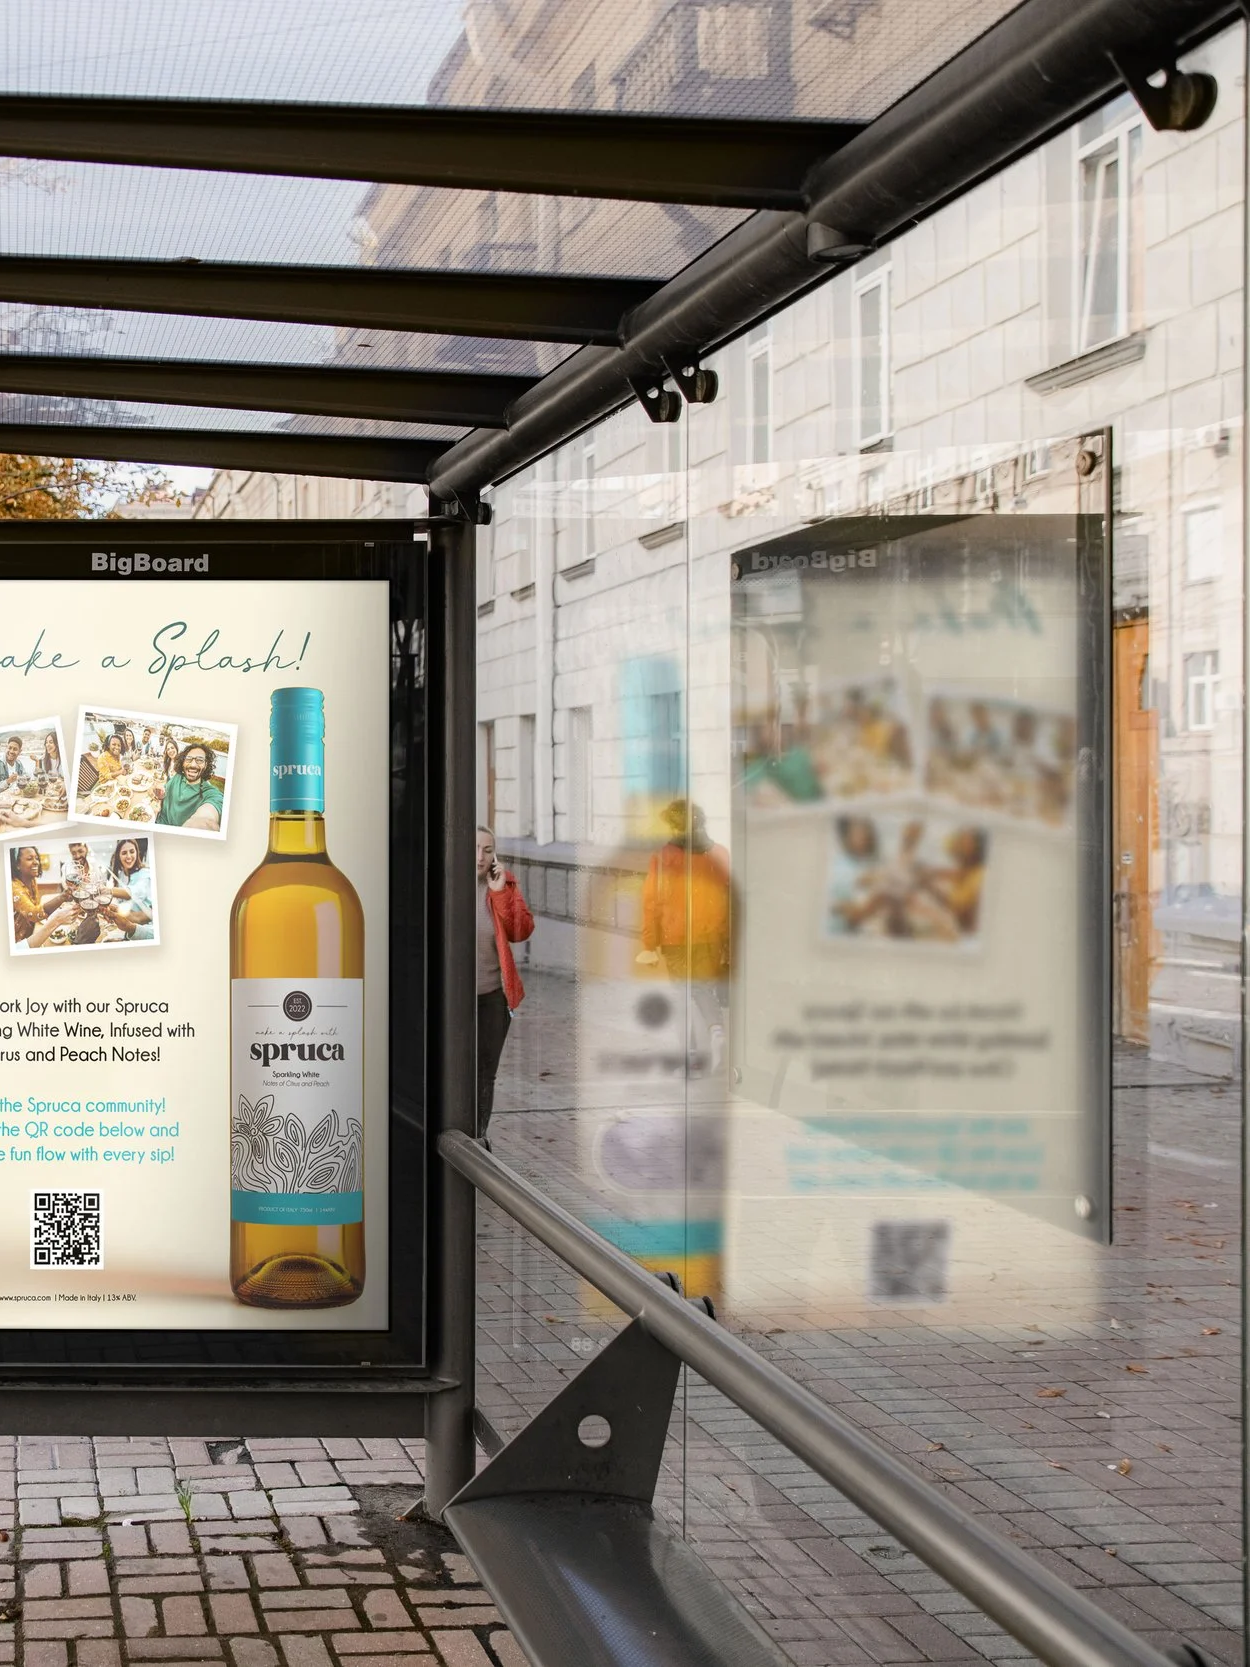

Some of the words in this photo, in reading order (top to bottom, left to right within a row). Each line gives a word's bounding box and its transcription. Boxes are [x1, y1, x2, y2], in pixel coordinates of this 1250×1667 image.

[91, 552, 209, 576] BigBoard
[101, 653, 130, 669] a
[148, 621, 312, 698] Splash!
[272, 764, 322, 780] spruca
[26, 998, 49, 1016] Joy
[53, 998, 81, 1013] with
[86, 1001, 110, 1013] our
[115, 997, 169, 1016] Spruca
[289, 1004, 306, 1013] 2022
[17, 1022, 60, 1038] White
[64, 1022, 105, 1039] Wine,
[110, 1022, 162, 1038] Infused
[167, 1022, 195, 1038] with
[25, 1046, 56, 1062] and
[60, 1046, 107, 1062] Peach
[112, 1046, 161, 1062] Notes!
[250, 1042, 345, 1067] spruca
[272, 1070, 301, 1079] Sparkling
[302, 1070, 320, 1078] White
[27, 1097, 81, 1115] Spruca
[85, 1097, 166, 1116] community!
[24, 1121, 48, 1139] QR
[53, 1122, 95, 1137] code
[99, 1122, 146, 1137] below
[149, 1122, 180, 1137] and
[9, 1146, 32, 1162] fun
[36, 1146, 66, 1162] flow
[69, 1146, 99, 1162] with
[103, 1150, 146, 1165] every
[150, 1146, 175, 1165] sip!
[0, 1294, 51, 1303] www.spruca.com
[59, 1293, 79, 1302] Made
[80, 1293, 86, 1302] in
[87, 1293, 101, 1303] Italy
